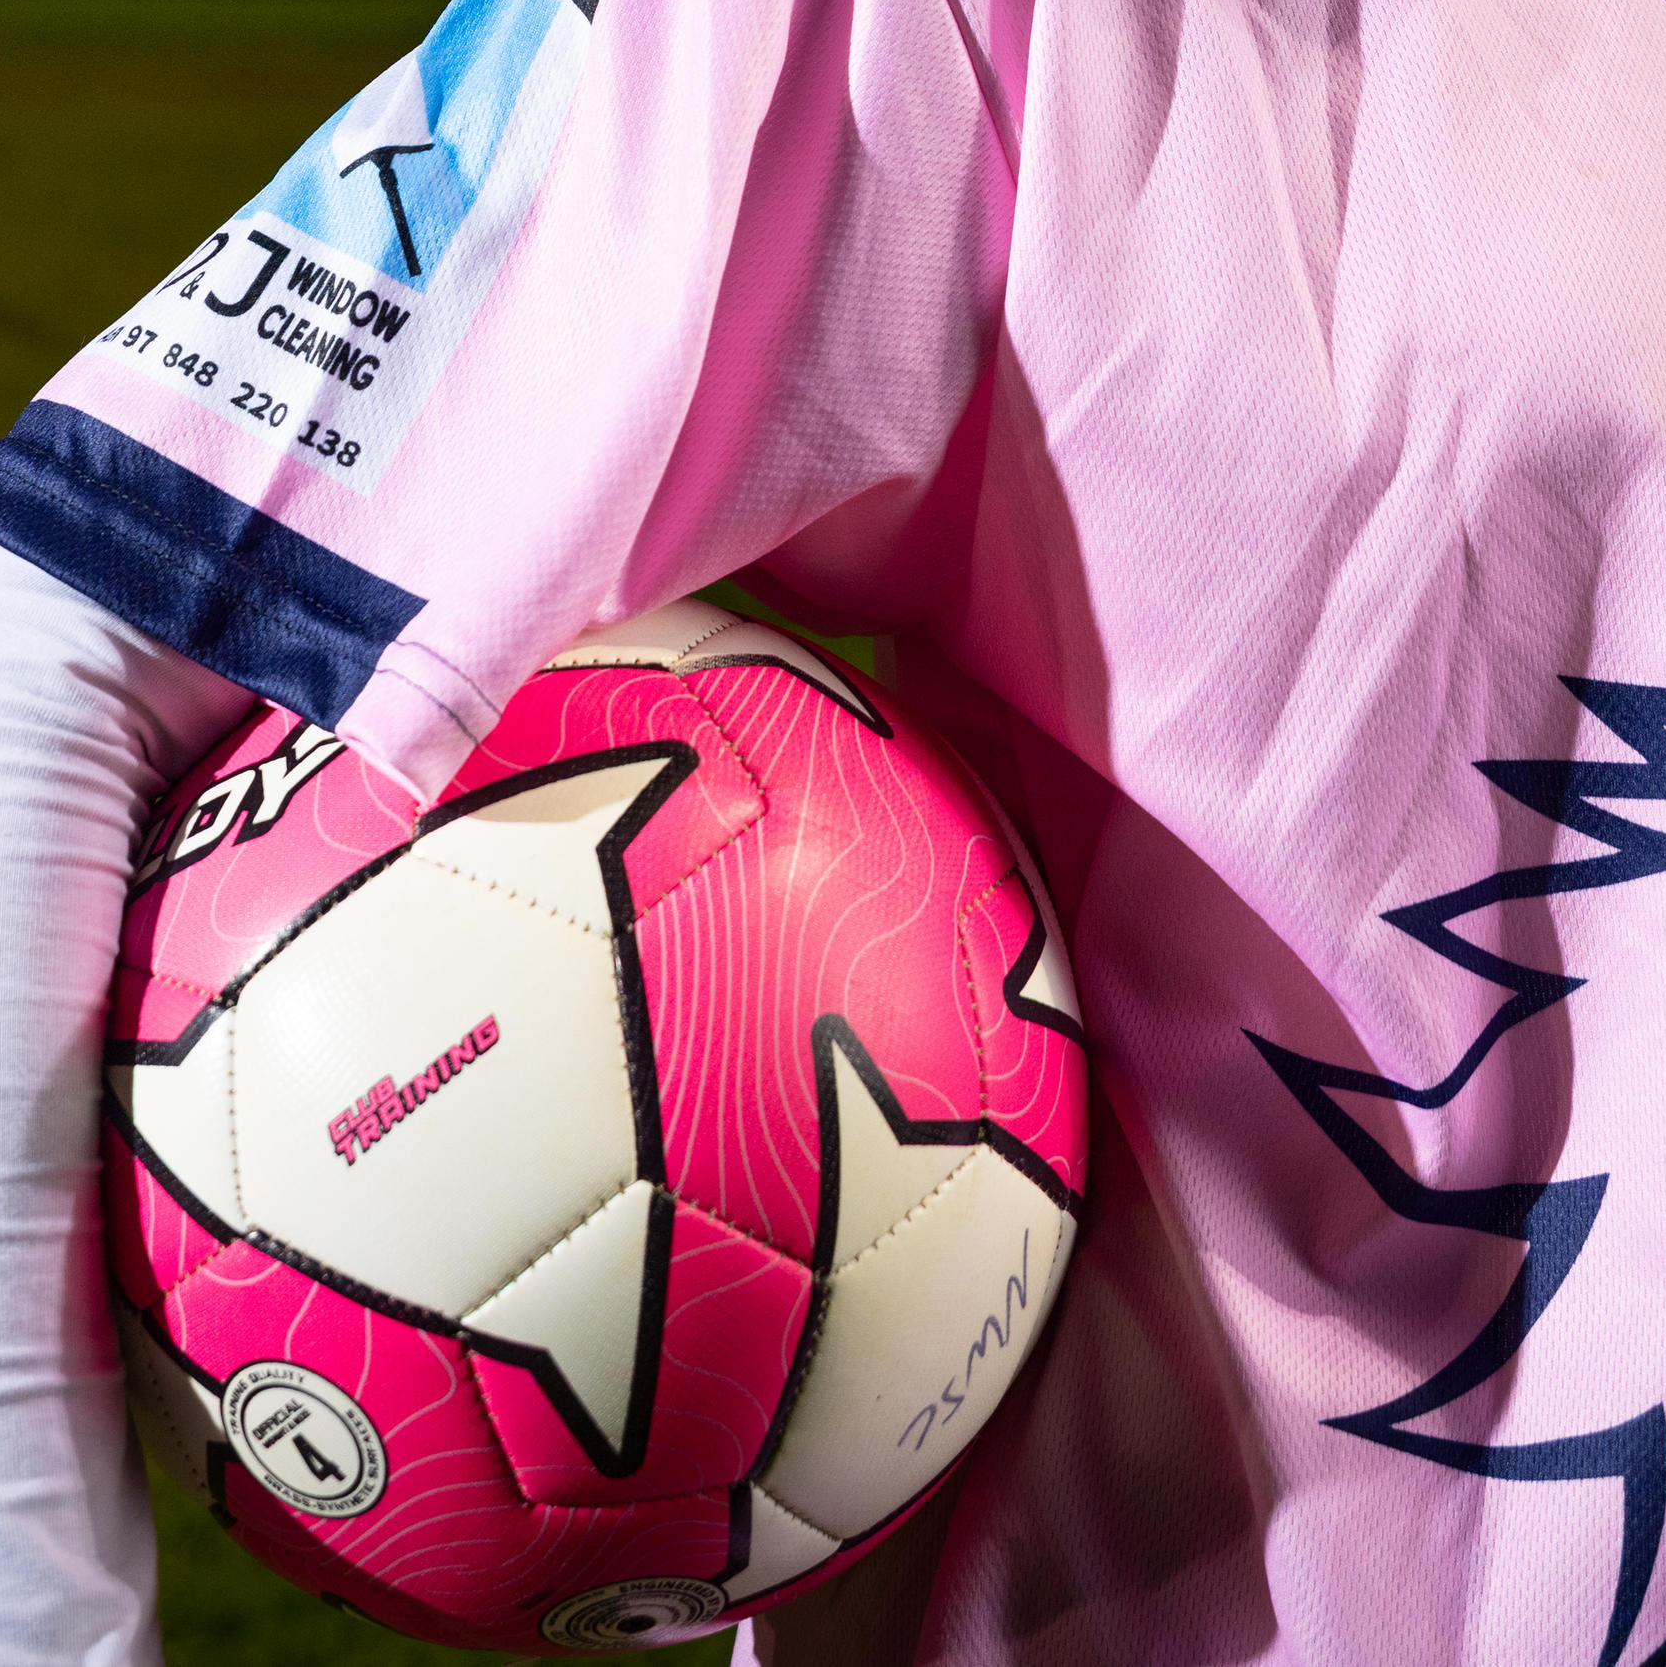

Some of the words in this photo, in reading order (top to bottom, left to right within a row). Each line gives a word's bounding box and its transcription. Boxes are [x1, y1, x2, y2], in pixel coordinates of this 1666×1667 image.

[179, 271, 206, 300] &
[204, 230, 291, 317] J
[287, 256, 411, 343] WINDOW
[257, 304, 380, 391] CLEANING
[162, 343, 219, 387] 848
[230, 382, 288, 428] 220
[297, 420, 361, 467] 138
[327, 1074, 395, 1144] CLUB
[334, 1014, 500, 1166] TRAINING
[252, 1398, 304, 1440] OFFICIAL
[292, 1432, 347, 1481] 4
[619, 1580, 716, 1598] ENGINEERED
